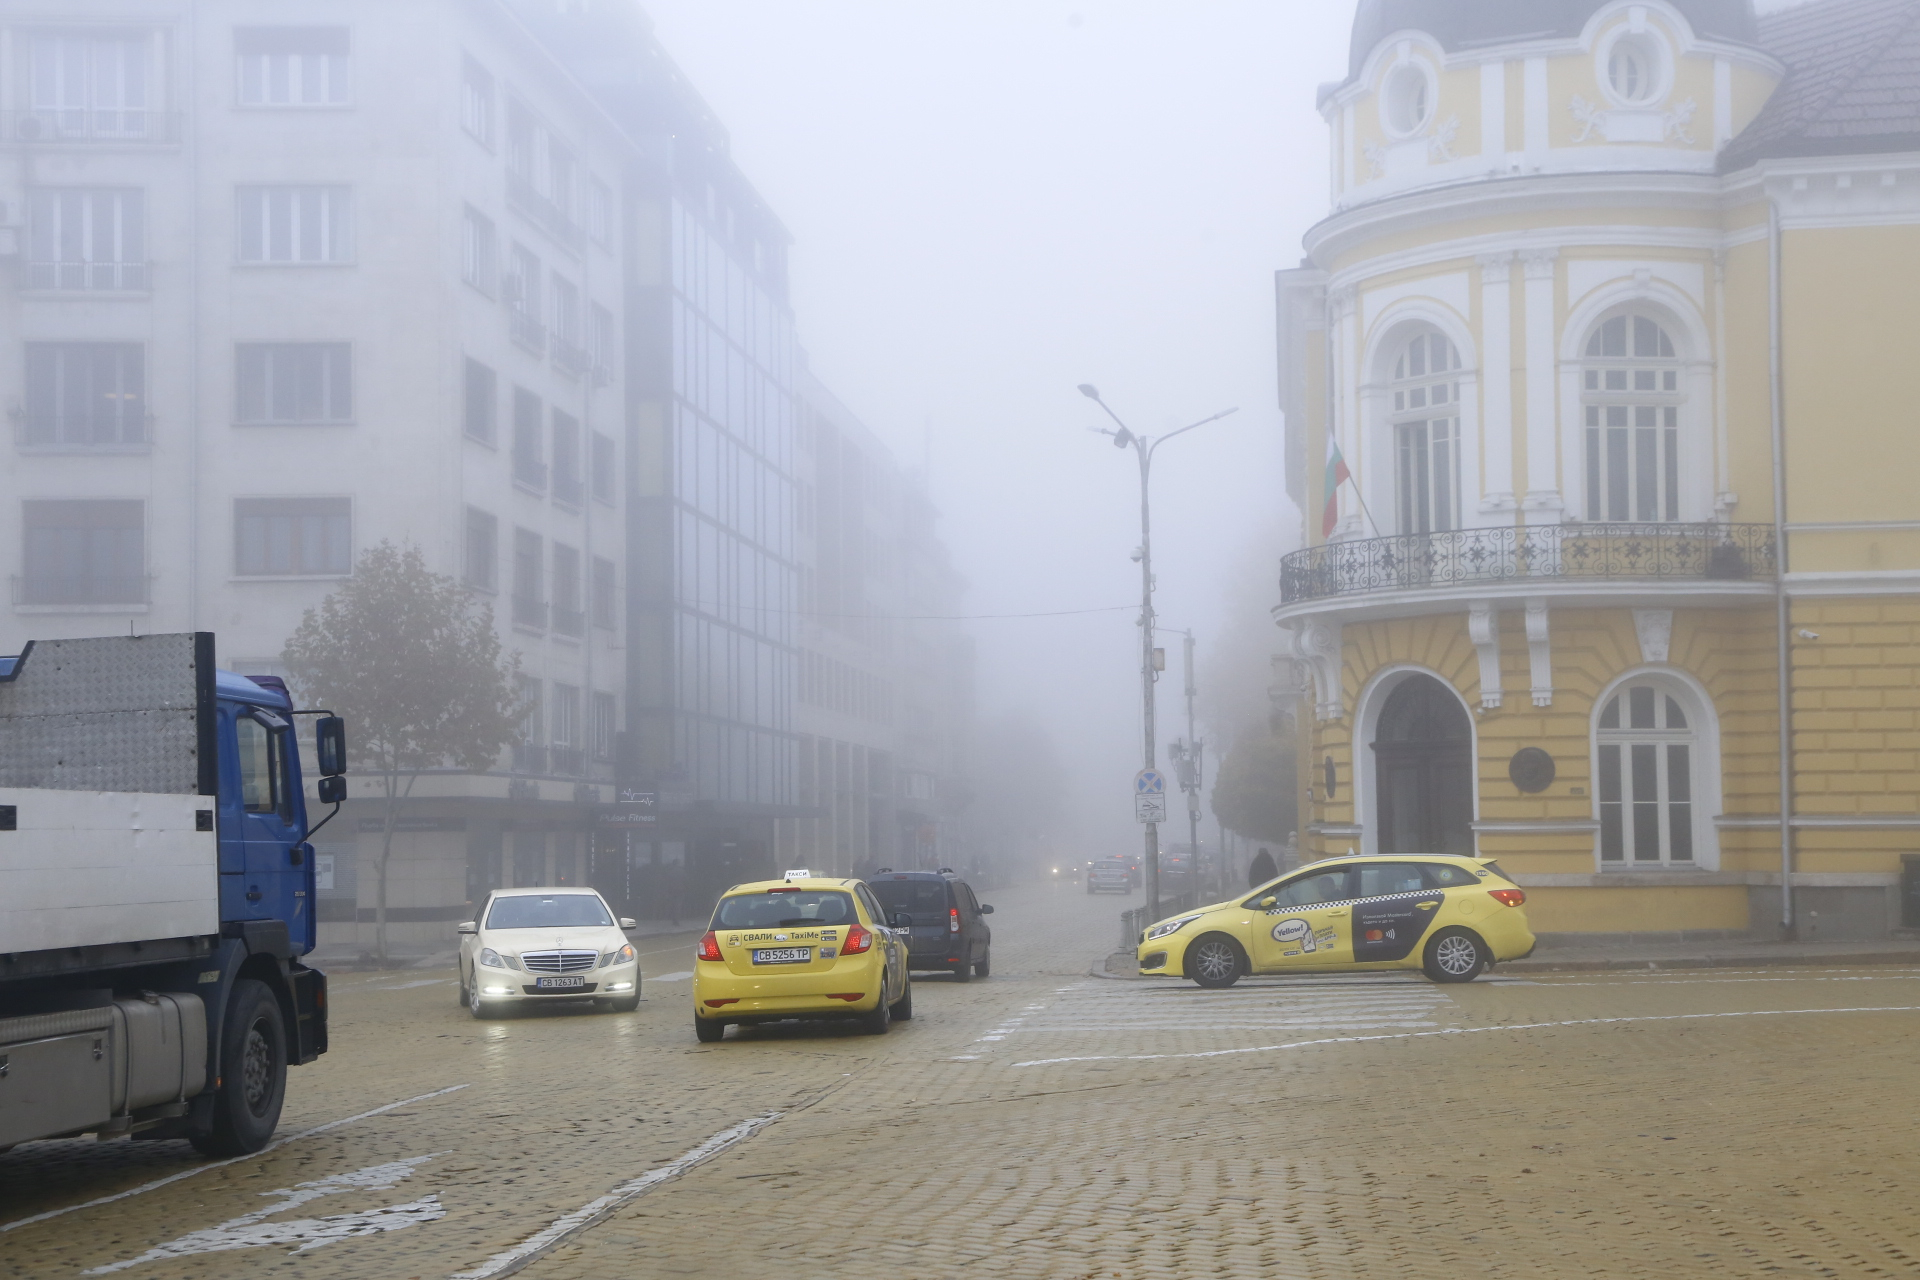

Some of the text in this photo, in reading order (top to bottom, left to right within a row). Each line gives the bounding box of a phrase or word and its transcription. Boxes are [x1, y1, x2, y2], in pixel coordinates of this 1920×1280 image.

[600, 813, 656, 822] Pulse Fitness
[1277, 924, 1304, 937] Yellow!
[743, 933, 773, 942] СВАЛИ
[790, 931, 819, 940] TaxiMe
[759, 951, 771, 960] CB
[772, 950, 795, 960] 5256
[796, 949, 809, 959] TP
[555, 978, 572, 986] 1263
